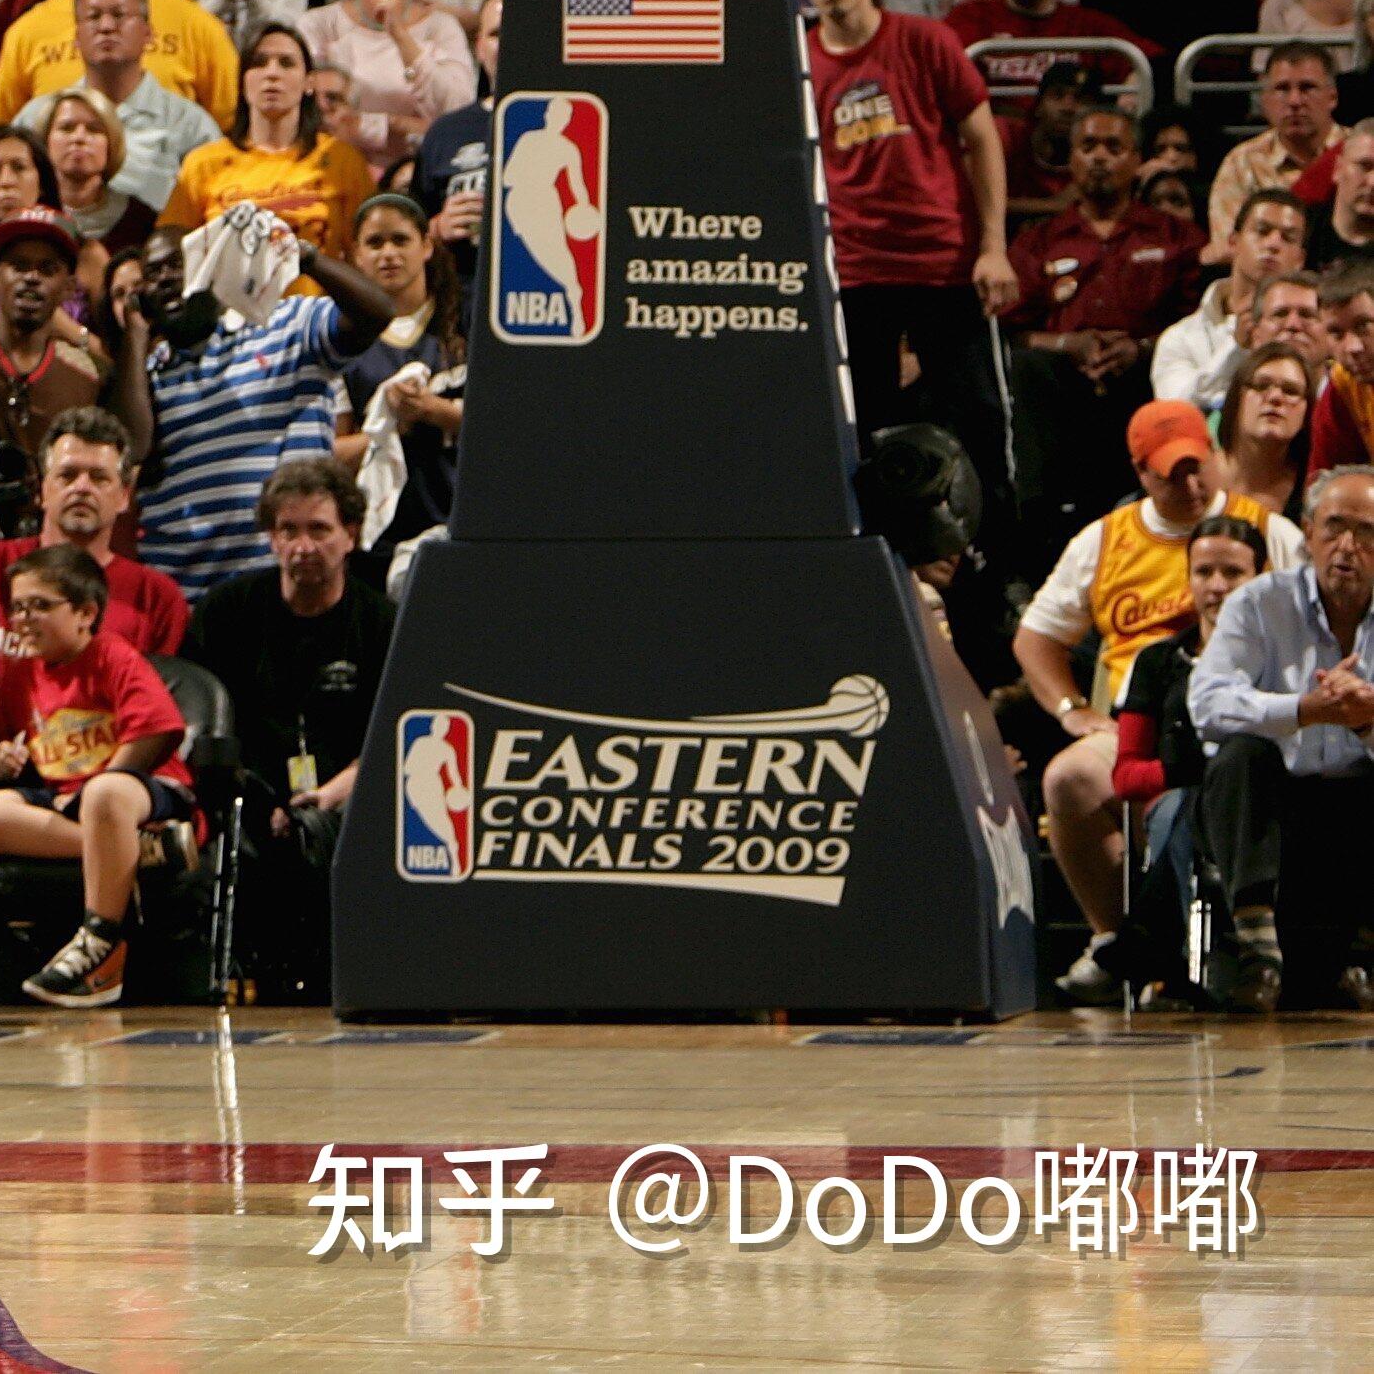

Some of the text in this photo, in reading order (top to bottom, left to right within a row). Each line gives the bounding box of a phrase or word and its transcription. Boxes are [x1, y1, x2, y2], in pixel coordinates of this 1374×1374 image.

[41, 32, 180, 64] WISS
[627, 205, 763, 241] Where
[625, 253, 809, 295] amazing
[505, 289, 569, 326] NBA
[625, 296, 809, 339] happens.
[481, 729, 877, 798] EASTERN
[479, 794, 858, 833] CONFERENCE
[407, 844, 449, 871] NBA
[473, 832, 851, 876] FINALS 2009
